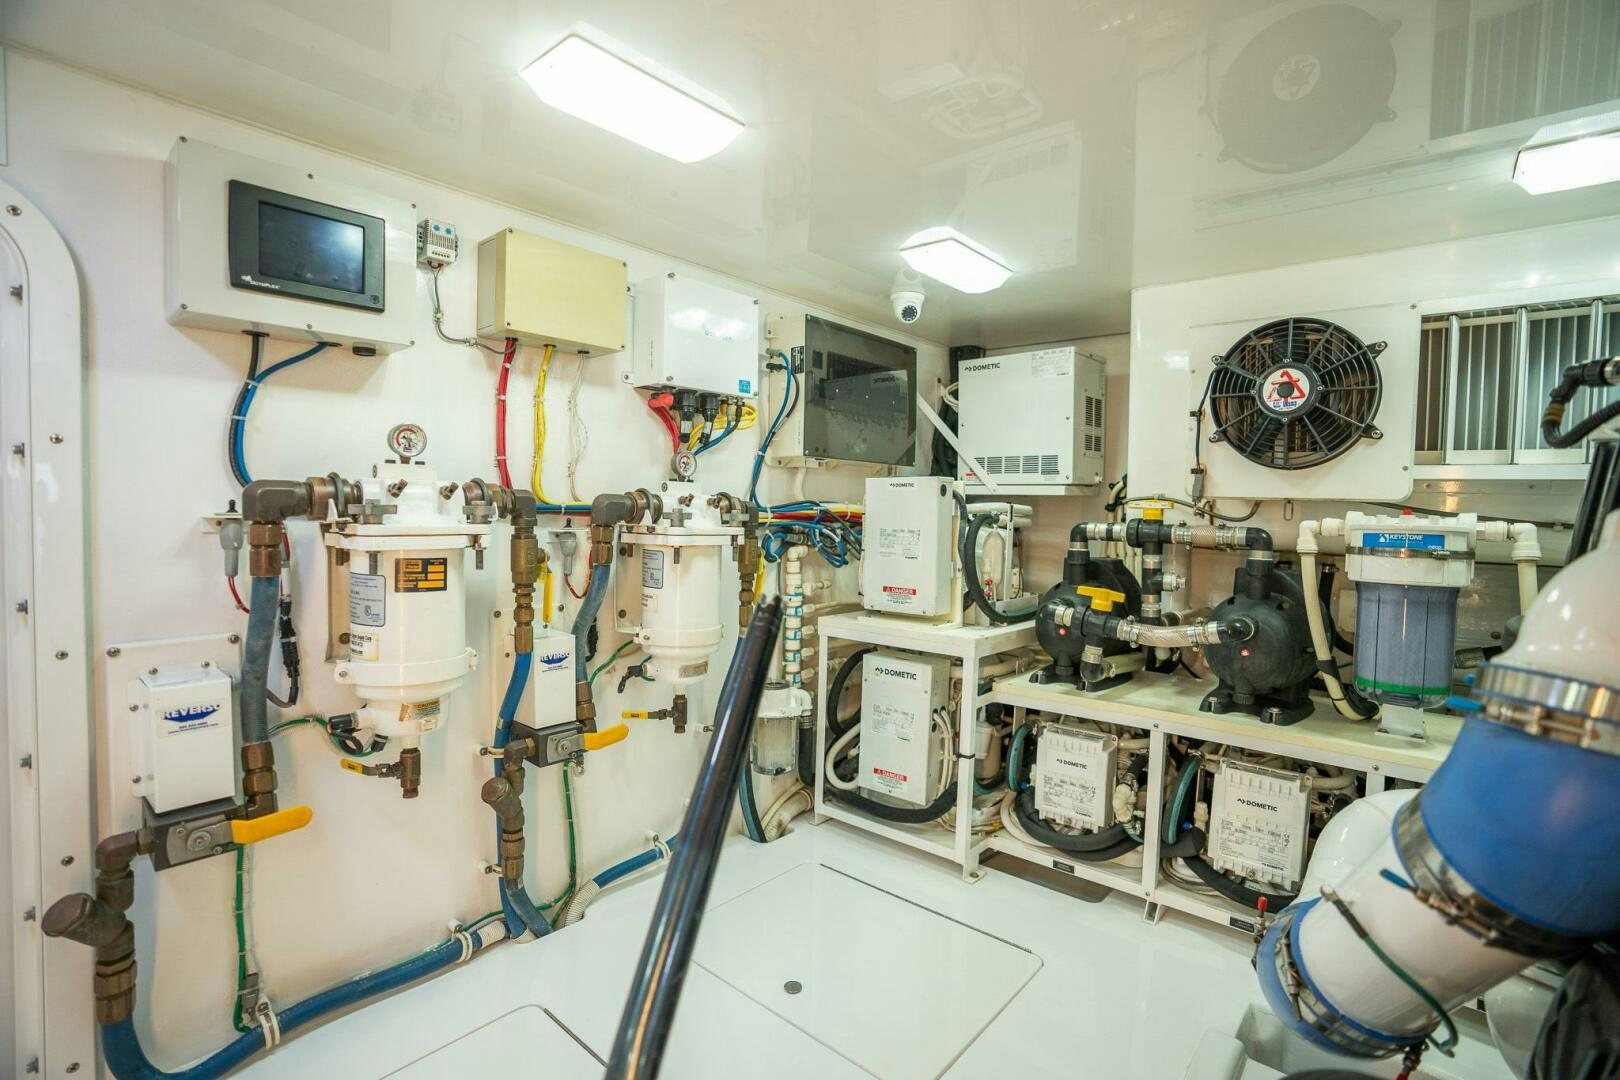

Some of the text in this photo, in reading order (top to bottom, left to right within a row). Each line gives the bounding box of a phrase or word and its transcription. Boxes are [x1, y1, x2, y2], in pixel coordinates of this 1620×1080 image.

[972, 362, 1001, 372] DOMETIC
[892, 587, 913, 595] DANGER
[884, 668, 917, 680] DOMETIC
[1063, 760, 1087, 770] DOMETIC
[883, 769, 905, 780] DANGER
[1246, 800, 1278, 812] DOMETIC
